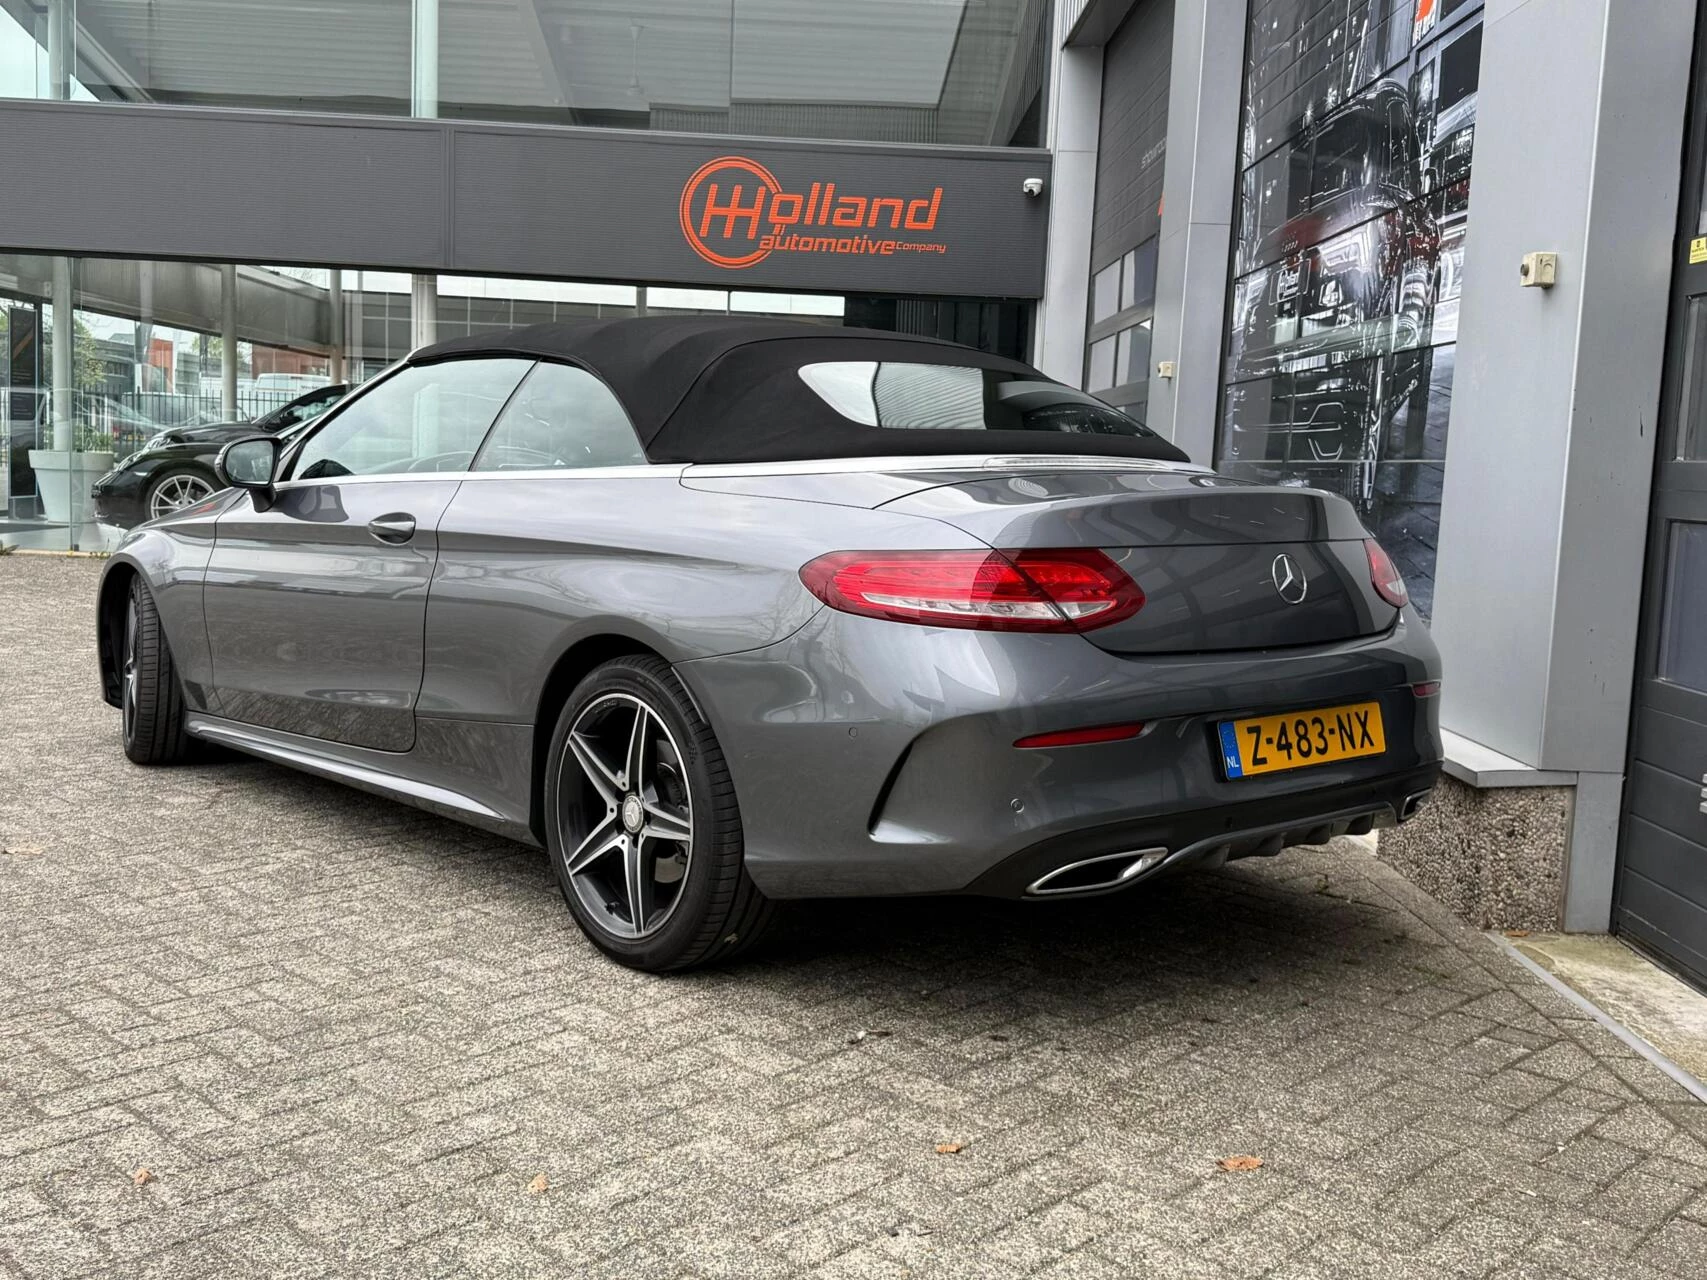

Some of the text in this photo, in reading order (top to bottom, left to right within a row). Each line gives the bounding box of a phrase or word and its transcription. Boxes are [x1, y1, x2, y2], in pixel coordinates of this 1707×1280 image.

[759, 234, 897, 255] automotive
[1227, 710, 1375, 768] NL Z-483-NX
